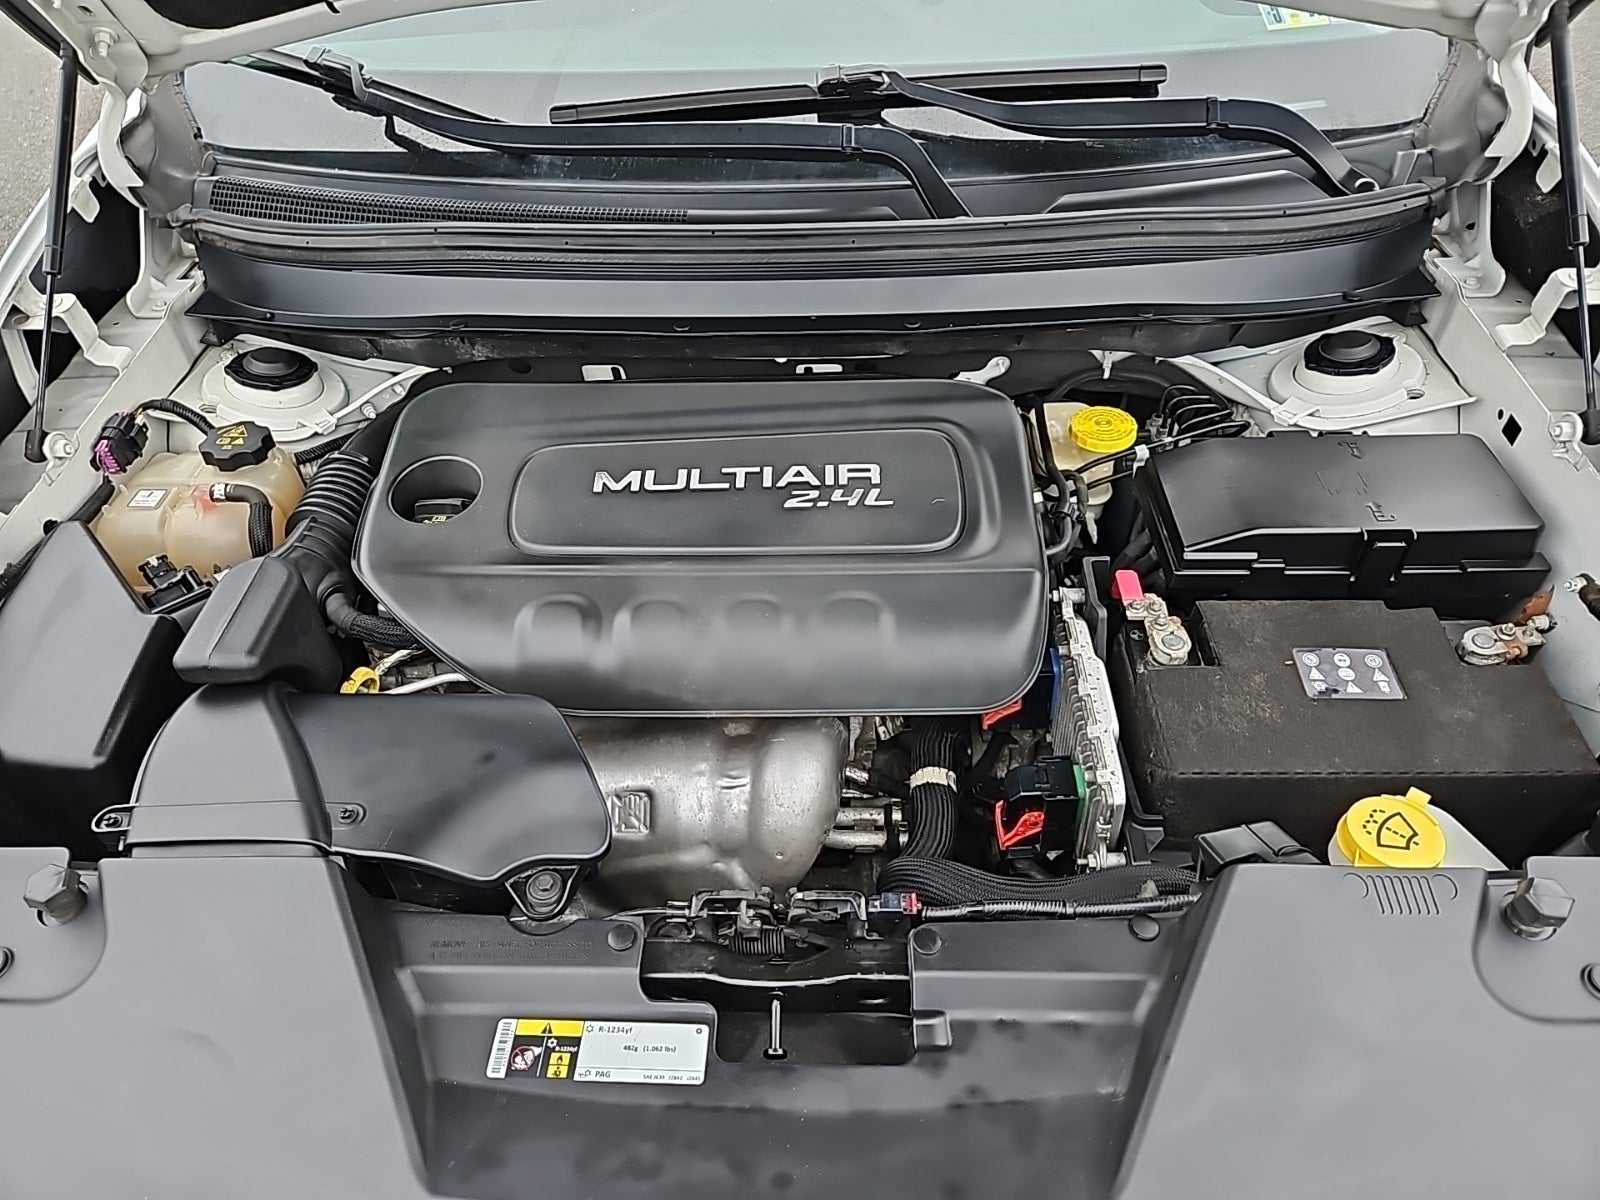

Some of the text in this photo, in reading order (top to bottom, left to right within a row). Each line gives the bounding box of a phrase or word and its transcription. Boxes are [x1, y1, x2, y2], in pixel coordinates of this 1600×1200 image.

[592, 463, 881, 493] MULTIAIR
[782, 488, 895, 509] 2.4L
[598, 1025, 633, 1035] R-1234yf
[622, 1044, 639, 1053] 482g
[594, 1070, 611, 1079] PAG
